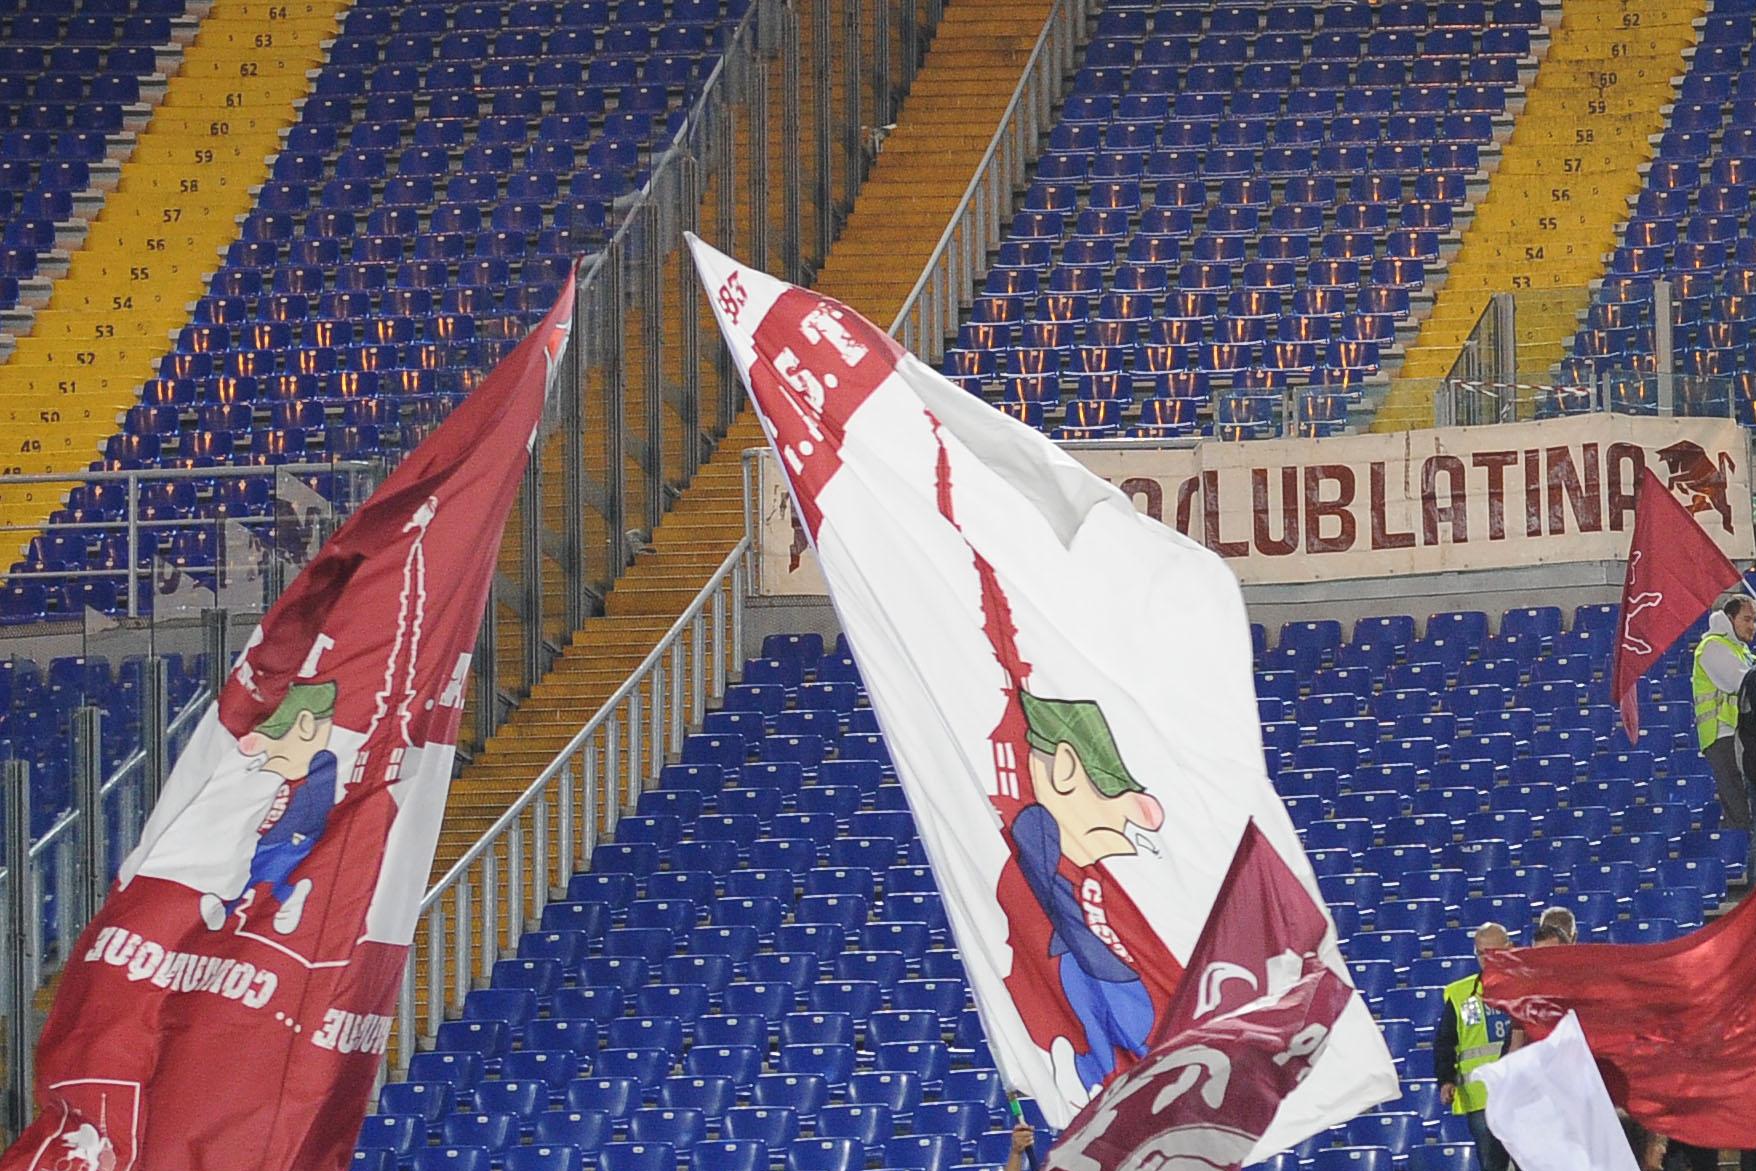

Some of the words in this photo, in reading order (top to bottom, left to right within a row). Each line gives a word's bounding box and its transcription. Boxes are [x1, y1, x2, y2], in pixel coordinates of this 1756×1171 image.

[270, 7, 286, 20] 64
[1623, 14, 1639, 26] 62
[255, 35, 272, 49] 63
[1612, 44, 1626, 56] 61
[241, 63, 257, 77] 62
[226, 94, 241, 108] 61
[1589, 101, 1605, 114] 59
[211, 123, 228, 136] 60
[1577, 130, 1593, 142] 58
[196, 150, 212, 163] 59
[1565, 159, 1581, 172] 57
[181, 180, 197, 193] 58
[1552, 190, 1569, 201] 56
[164, 209, 181, 222] 57
[1540, 218, 1556, 229] 55
[147, 239, 164, 250] 56
[1526, 247, 1543, 260] 54
[131, 268, 148, 280] 55
[1513, 277, 1530, 288] 53
[114, 297, 132, 310] 54
[96, 325, 113, 338] 53
[77, 353, 95, 364] 52
[59, 382, 75, 393] 51
[41, 412, 59, 422] 50
[21, 440, 41, 452] 49
[1371, 440, 1645, 550] LATINA
